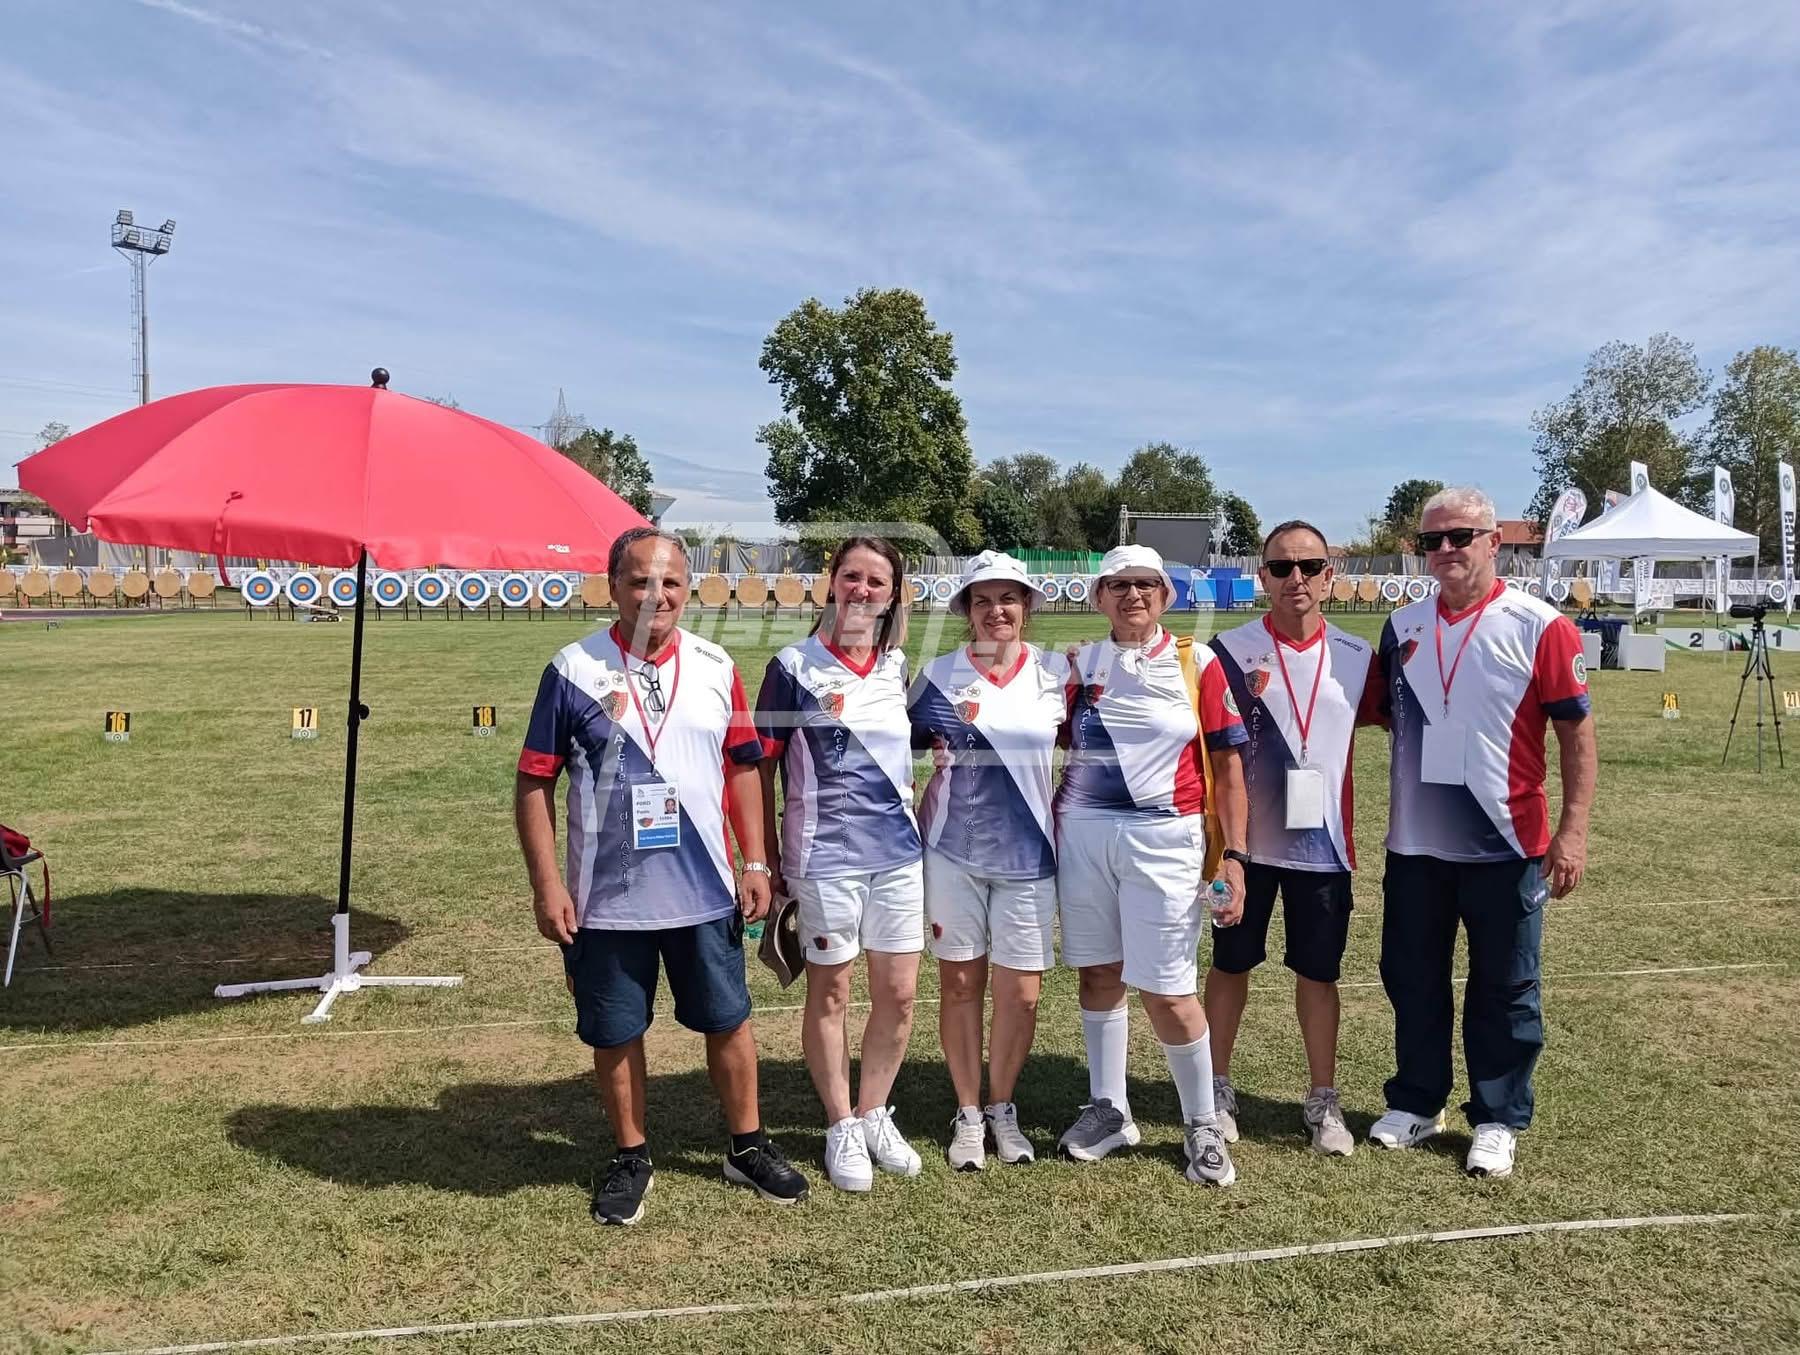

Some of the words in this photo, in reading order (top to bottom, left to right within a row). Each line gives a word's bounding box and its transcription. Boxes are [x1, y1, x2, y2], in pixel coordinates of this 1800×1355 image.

[1689, 632, 1702, 647] 2
[1772, 630, 1782, 647] 1
[1395, 676, 1405, 737] Arciei
[1663, 693, 1677, 710] 26
[1786, 691, 1797, 707] 27
[109, 712, 126, 732] 16
[299, 708, 312, 728] 17
[476, 707, 492, 727] 18
[613, 732, 627, 802] Arcieri
[966, 733, 978, 788] Arcieri
[619, 810, 629, 832] di
